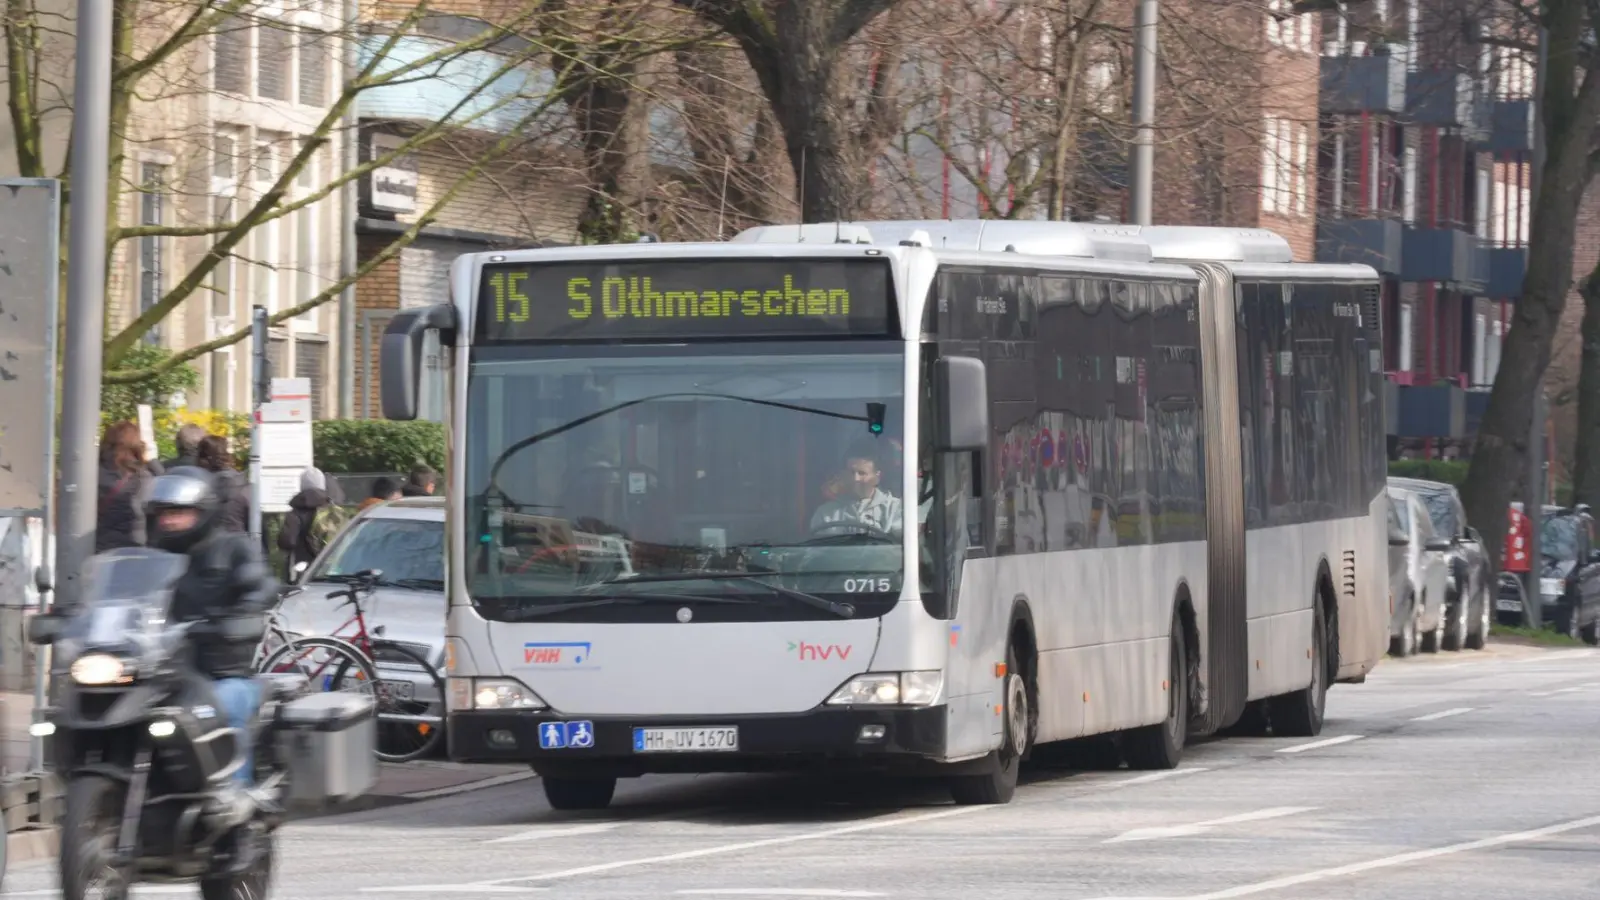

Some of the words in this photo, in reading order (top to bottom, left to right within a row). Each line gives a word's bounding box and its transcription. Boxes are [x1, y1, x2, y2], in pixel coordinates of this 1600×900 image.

[489, 272, 530, 322] 15
[567, 277, 592, 319] S
[602, 274, 849, 318] Othmarschen
[844, 578, 891, 593] 0715
[524, 647, 561, 664] VHH
[799, 641, 853, 660] hvv
[645, 731, 664, 749] HH
[675, 730, 695, 747] UV
[698, 729, 736, 748] 1670
